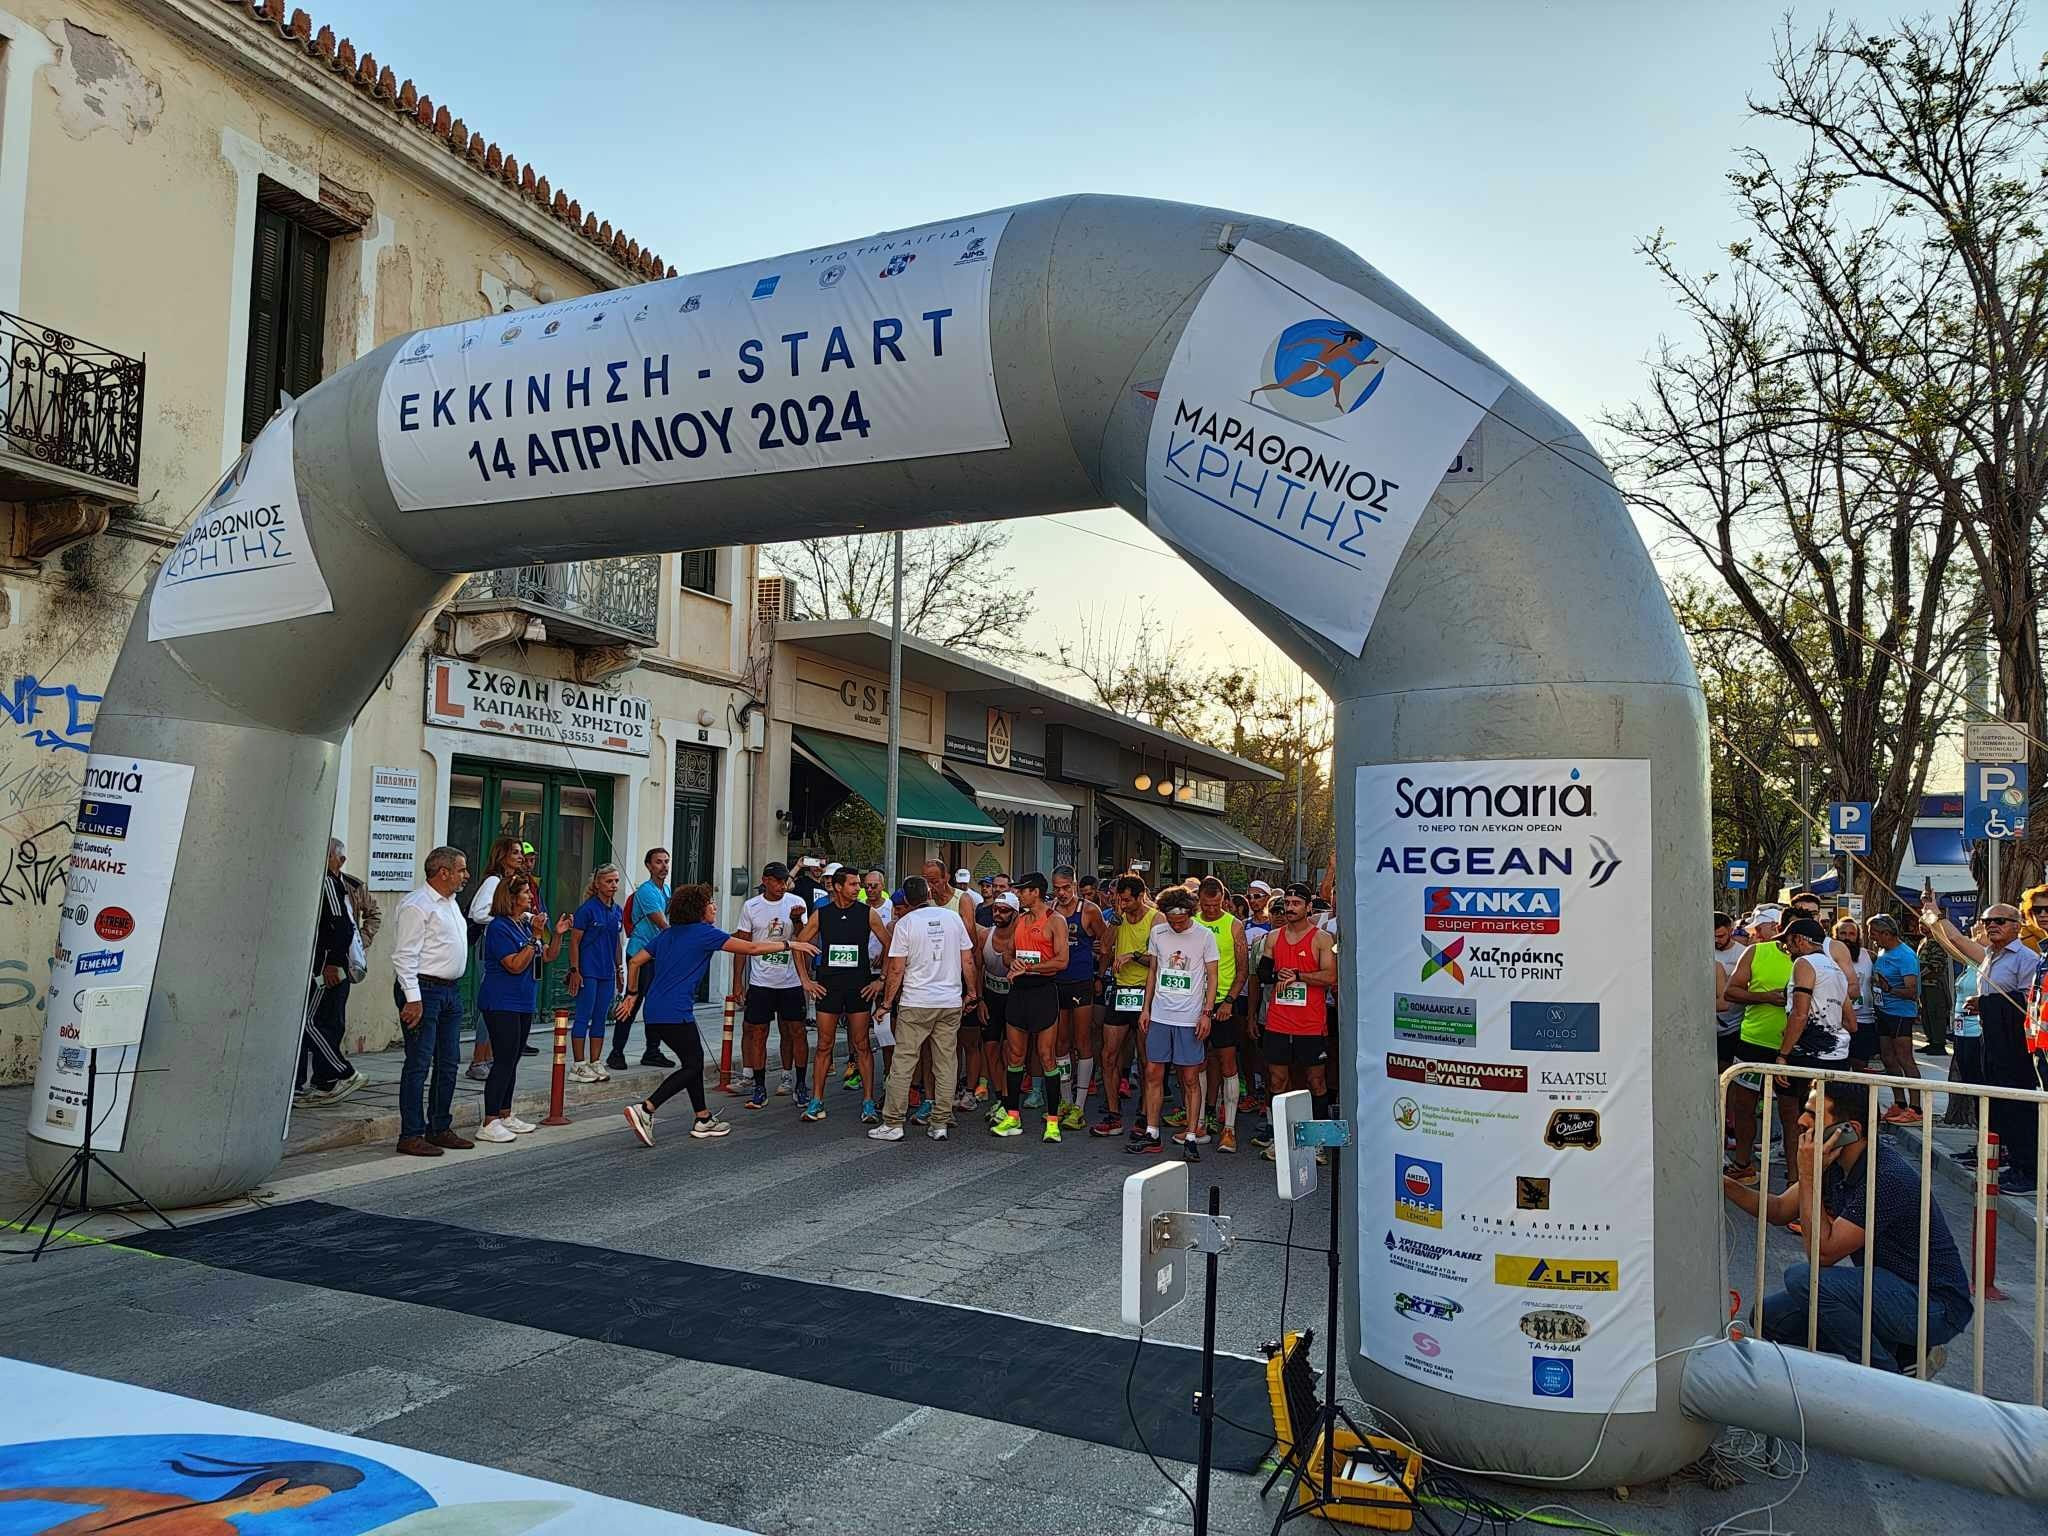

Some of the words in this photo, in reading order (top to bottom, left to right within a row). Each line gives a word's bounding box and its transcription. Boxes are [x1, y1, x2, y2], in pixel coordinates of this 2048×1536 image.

[809, 250, 848, 266] ΥΠΟ
[856, 241, 896, 257] ΤΗΝ
[903, 225, 976, 246] ΑΙΓΙΔΑ
[960, 250, 985, 260] AIMS
[399, 353, 670, 432] ΕΚΚΙΝΗΣΗ
[737, 306, 954, 385] START
[467, 436, 516, 483] 14
[527, 406, 734, 477] ΑΠΡΙΛΙΟΥ
[758, 389, 871, 450] 2024
[1174, 397, 1400, 512] ΜΑΡΑΘΩΝΙΟΣ
[1165, 431, 1382, 558] ΚΡΗΤΗΣ
[165, 528, 293, 580] ΚΡΗΤΗΣ
[466, 667, 550, 704] ΣΧΟΛΗ
[561, 687, 647, 721] ΟΔΗΓΩΝ
[472, 696, 563, 724] ΚΑΠΑΚΗΣ
[570, 713, 644, 738] ΧΡΗΣΤΟΣ
[526, 723, 555, 738] ΤΗΛ.
[561, 728, 595, 744] 53553
[83, 768, 143, 793] maria
[376, 774, 417, 788] ΔΙΠΛΩΜΑΤΑ
[1980, 767, 2016, 802] P
[1840, 806, 1860, 830] P
[88, 823, 123, 836] LINES
[1418, 824, 1430, 832] ΤΟ
[1431, 824, 1456, 832] ΝΕΡΟ
[1458, 824, 1479, 832] ΤΩΝ
[1481, 824, 1523, 832] ΛΕΥΚΩΝ
[372, 851, 414, 860] ΕΠΕΚΤΑΣΕΙΣ
[1376, 846, 1573, 876] AEGEAN
[1432, 886, 1553, 914] SYNKA
[1436, 918, 1478, 931] super
[1481, 920, 1545, 932] markets
[80, 956, 118, 970] TEMENIA
[766, 952, 785, 964] 252
[834, 952, 853, 961] 228
[1469, 946, 1564, 968] Χαζηράκης
[1470, 966, 1496, 979] ALL
[1499, 967, 1518, 980] TO
[1522, 968, 1563, 980] PRINT
[1166, 977, 1186, 988] 330
[1121, 996, 1138, 1006] 339
[1281, 990, 1300, 1000] 185
[1410, 1002, 1455, 1015] ΘΩΜΑΔΑΚΗΣ
[1402, 1032, 1466, 1046] www.thomadakis.gr
[1536, 1028, 1577, 1038] AIOLOS
[1541, 1071, 1608, 1086] KAATSU
[1556, 1120, 1595, 1135] Orsero
[1407, 1172, 1429, 1182] ΑΜΣΤΕΛ
[1400, 1196, 1436, 1215] FREE
[1406, 1211, 1430, 1222] LEMON
[1460, 1214, 1515, 1227] ΚΤΗΜΑ
[1532, 1221, 1611, 1232] ΛΟΥΠΑΚΗ
[1398, 1236, 1483, 1261] ΧΡΙΣΤΟΔΟΥΛΑΚΗΣ
[1398, 1244, 1442, 1260] ΑΝΤΩΝΙΟΥ
[1426, 1265, 1456, 1275] ΛΥΜΑΤΩΝ
[1528, 1258, 1610, 1284] ALFIX
